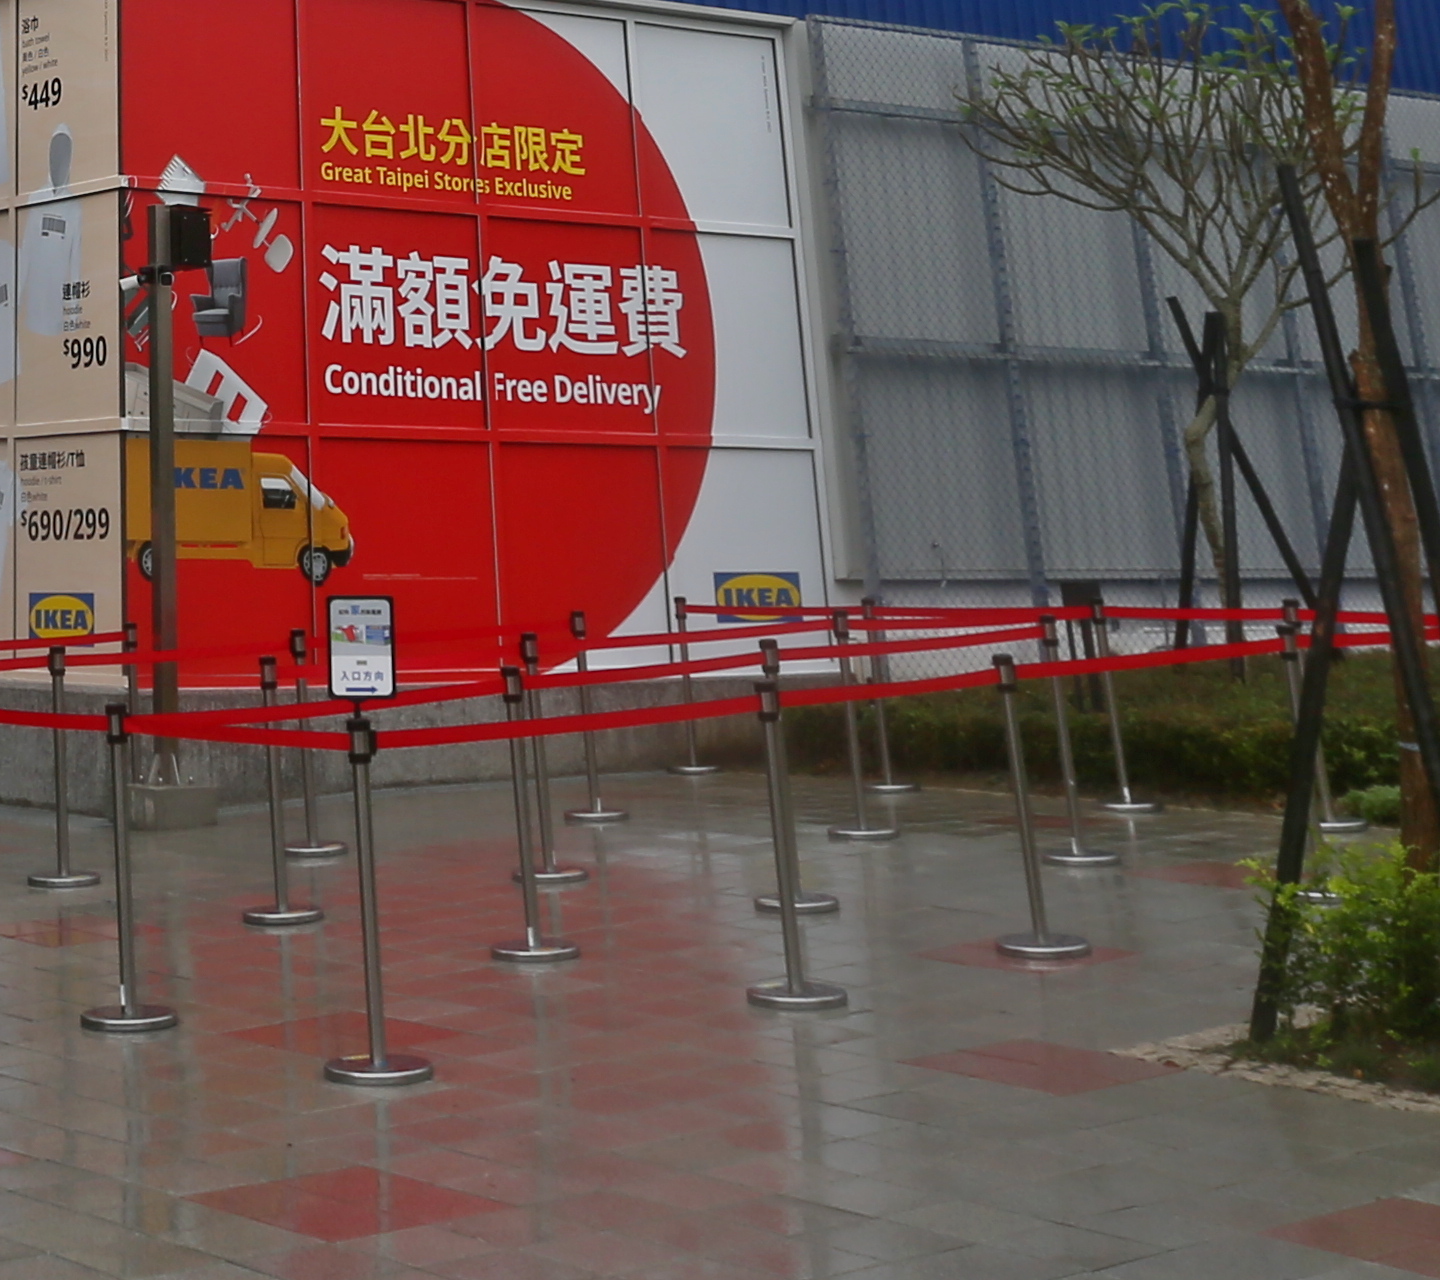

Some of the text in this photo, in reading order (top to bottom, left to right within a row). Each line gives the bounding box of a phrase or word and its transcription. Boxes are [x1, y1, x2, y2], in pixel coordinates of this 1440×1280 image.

[21, 15, 39, 34] 浴巾
[22, 77, 62, 110] $449
[321, 106, 586, 175] 大台北分店限定
[321, 162, 572, 200] Great Taipei Stores Exclusive
[319, 244, 687, 358] 滿額免運費
[63, 336, 107, 369] $990
[324, 363, 661, 414] Conditional Free Delivery
[174, 467, 244, 490] KEA
[21, 507, 110, 541] $690/299
[723, 588, 794, 607] IKEA
[35, 609, 89, 630] IKEA
[341, 670, 384, 682] 入口方向
